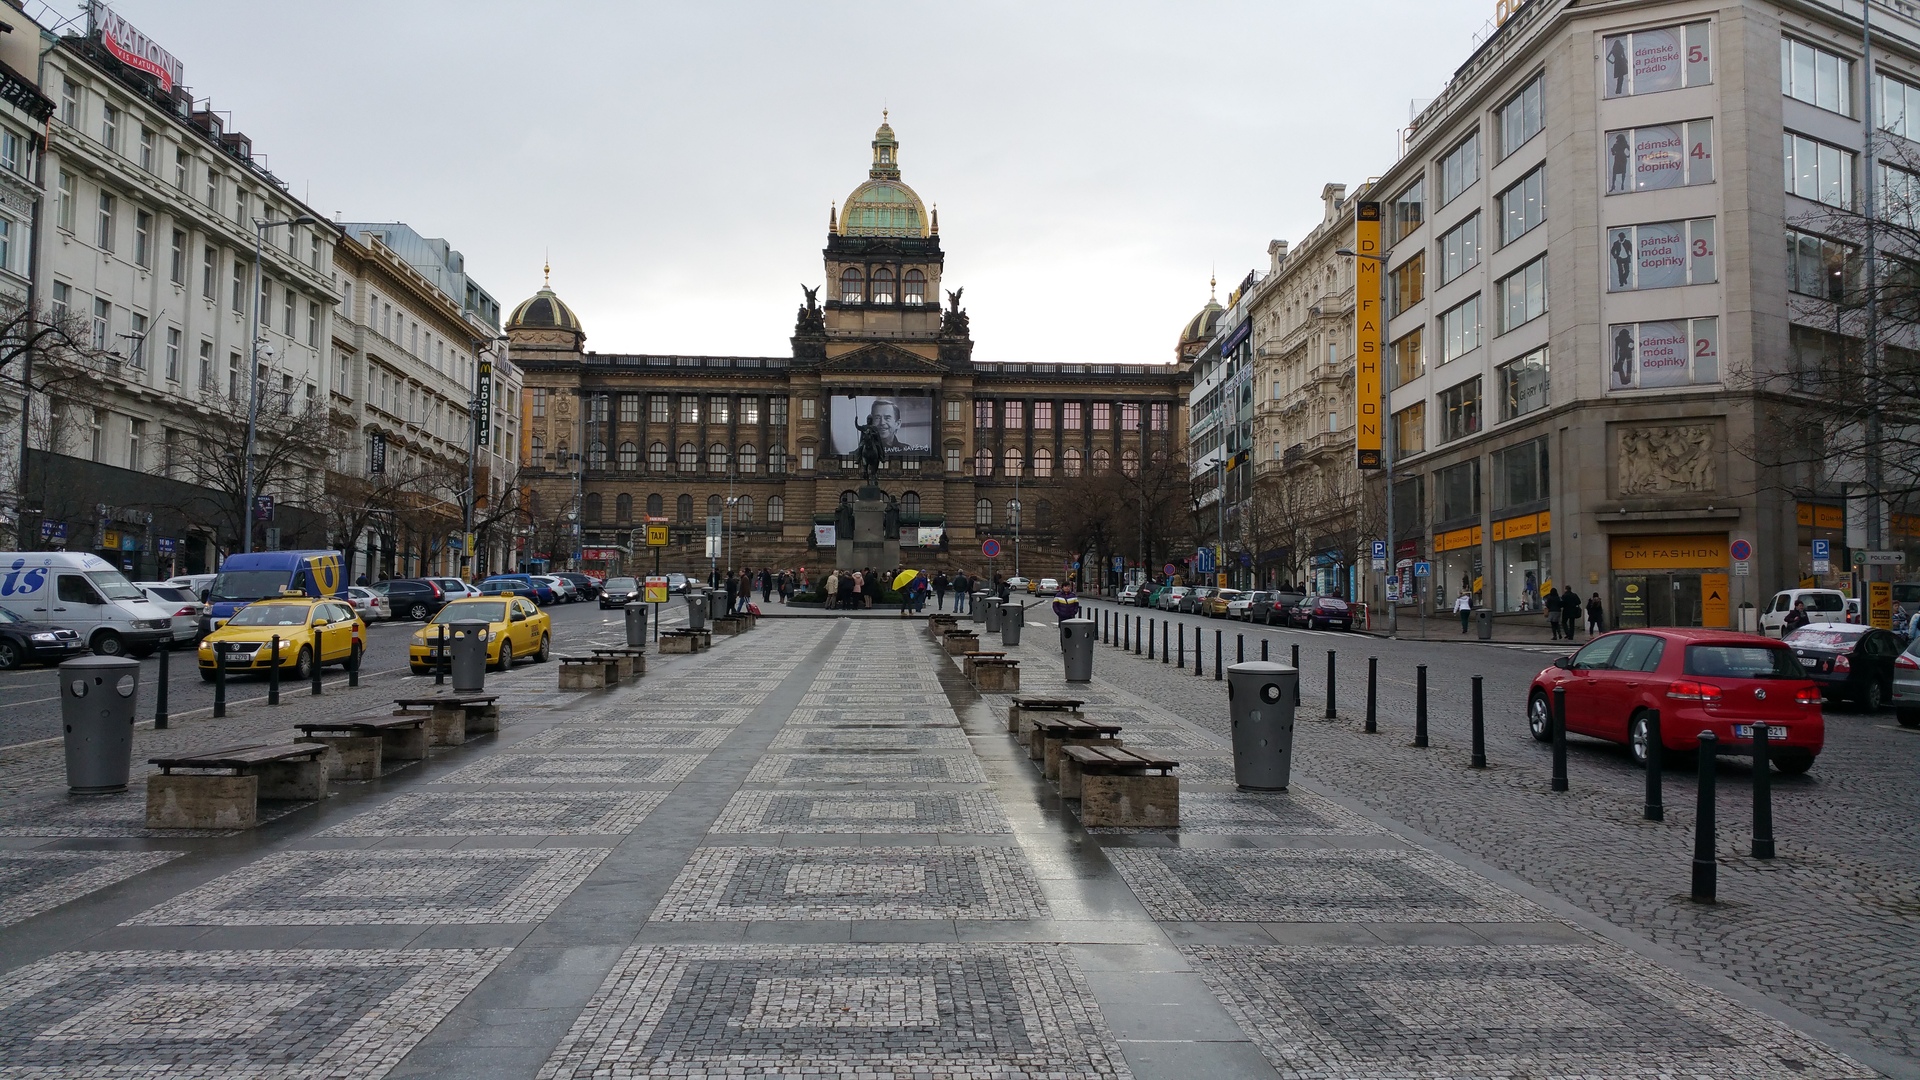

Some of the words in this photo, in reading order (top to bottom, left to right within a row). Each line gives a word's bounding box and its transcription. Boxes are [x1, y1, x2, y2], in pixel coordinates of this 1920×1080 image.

[94, 5, 178, 85] MATTONI
[1635, 45, 1673, 58] dámské
[1644, 51, 1679, 67] pánské
[1688, 45, 1708, 64] 5.
[117, 49, 129, 61] VIS
[133, 57, 164, 77] NATURAE
[1635, 62, 1667, 76] prádlo
[1637, 137, 1681, 151] dámská
[1690, 142, 1710, 160] 4.
[1637, 150, 1669, 162] móda
[1637, 160, 1681, 174] doplňky
[1641, 234, 1680, 248] pánská
[1692, 239, 1714, 257] 3.
[1641, 246, 1672, 257] móda
[1641, 256, 1684, 269] doplňky
[1643, 335, 1685, 347] dámská
[1695, 338, 1716, 357] 2.
[1643, 346, 1673, 357] móda
[1362, 300, 1375, 435] FASHION
[1643, 356, 1686, 369] doplňky
[480, 377, 489, 444] McDonald's
[650, 531, 664, 540] TAXI
[1374, 543, 1383, 554] P
[1653, 549, 1719, 558] FASHION
[1816, 542, 1826, 554] P
[1, 559, 48, 597] is
